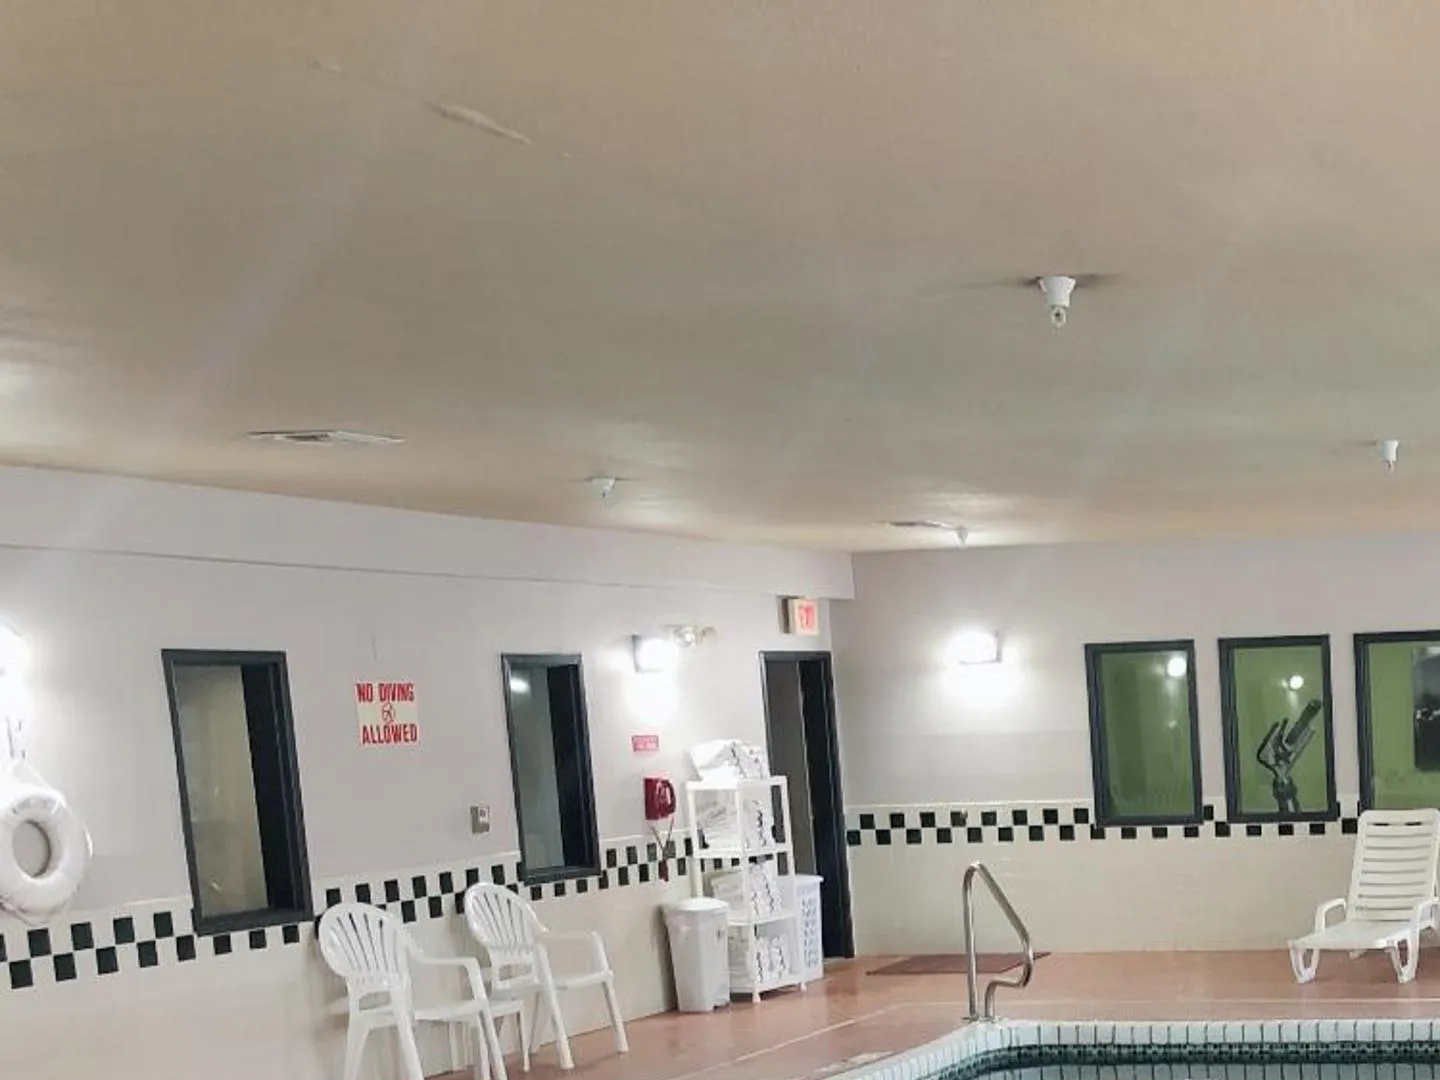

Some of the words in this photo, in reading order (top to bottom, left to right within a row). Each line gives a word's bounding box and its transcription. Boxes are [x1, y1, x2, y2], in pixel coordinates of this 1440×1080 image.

[356, 682, 373, 702] NO
[378, 682, 415, 702] DIVING
[362, 723, 418, 744] ALLOWED
